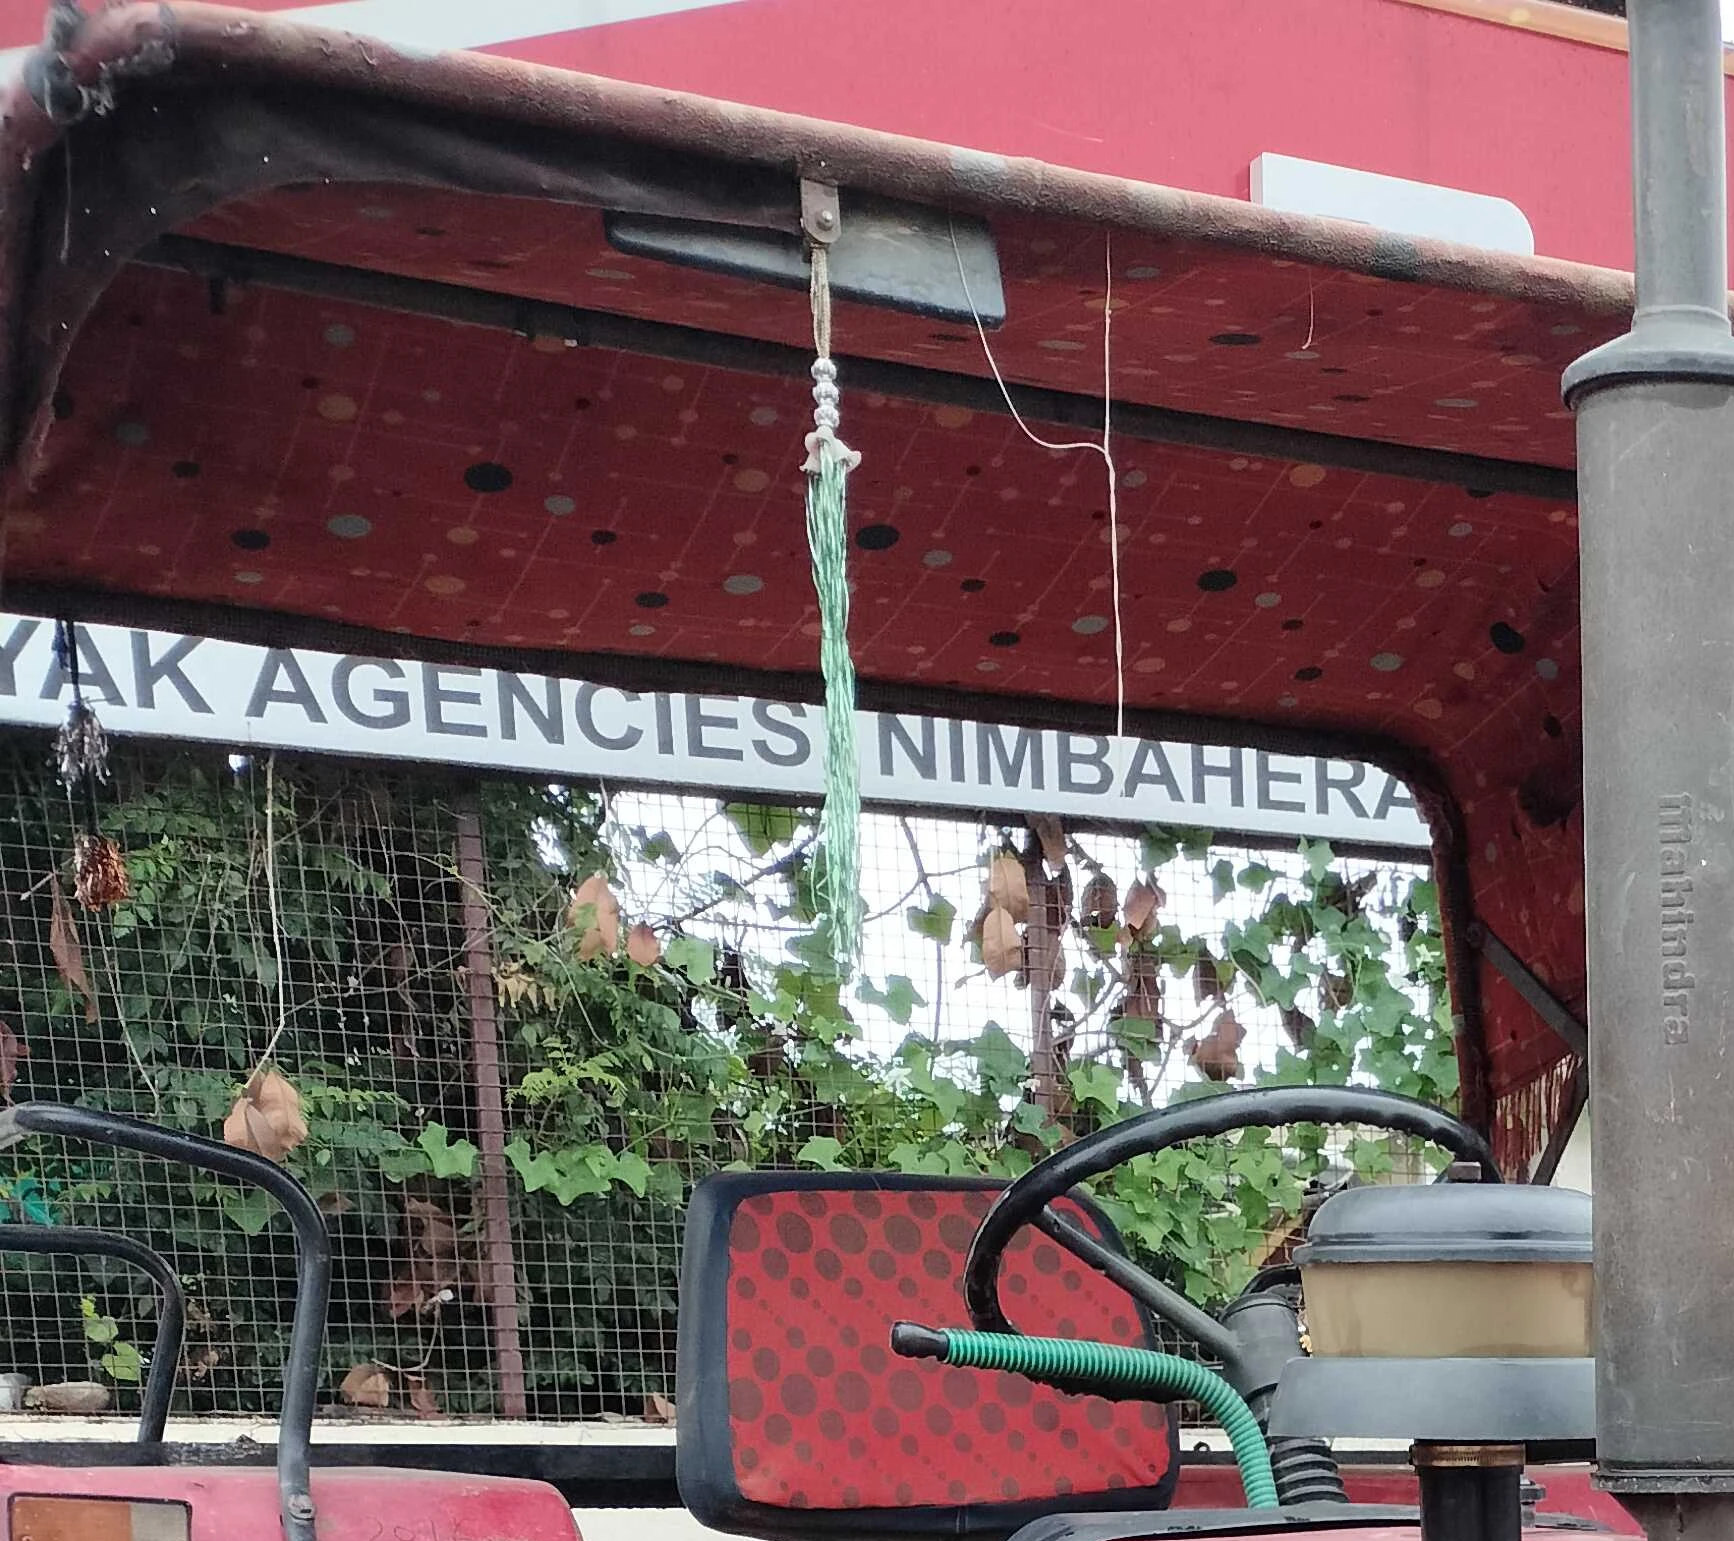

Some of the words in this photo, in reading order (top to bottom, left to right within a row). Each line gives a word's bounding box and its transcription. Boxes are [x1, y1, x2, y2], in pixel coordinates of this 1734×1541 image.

[245, 647, 811, 768] AGENCIES
[877, 713, 1429, 825] NIMBAHERA
[1658, 791, 1696, 1046] Mahindra
